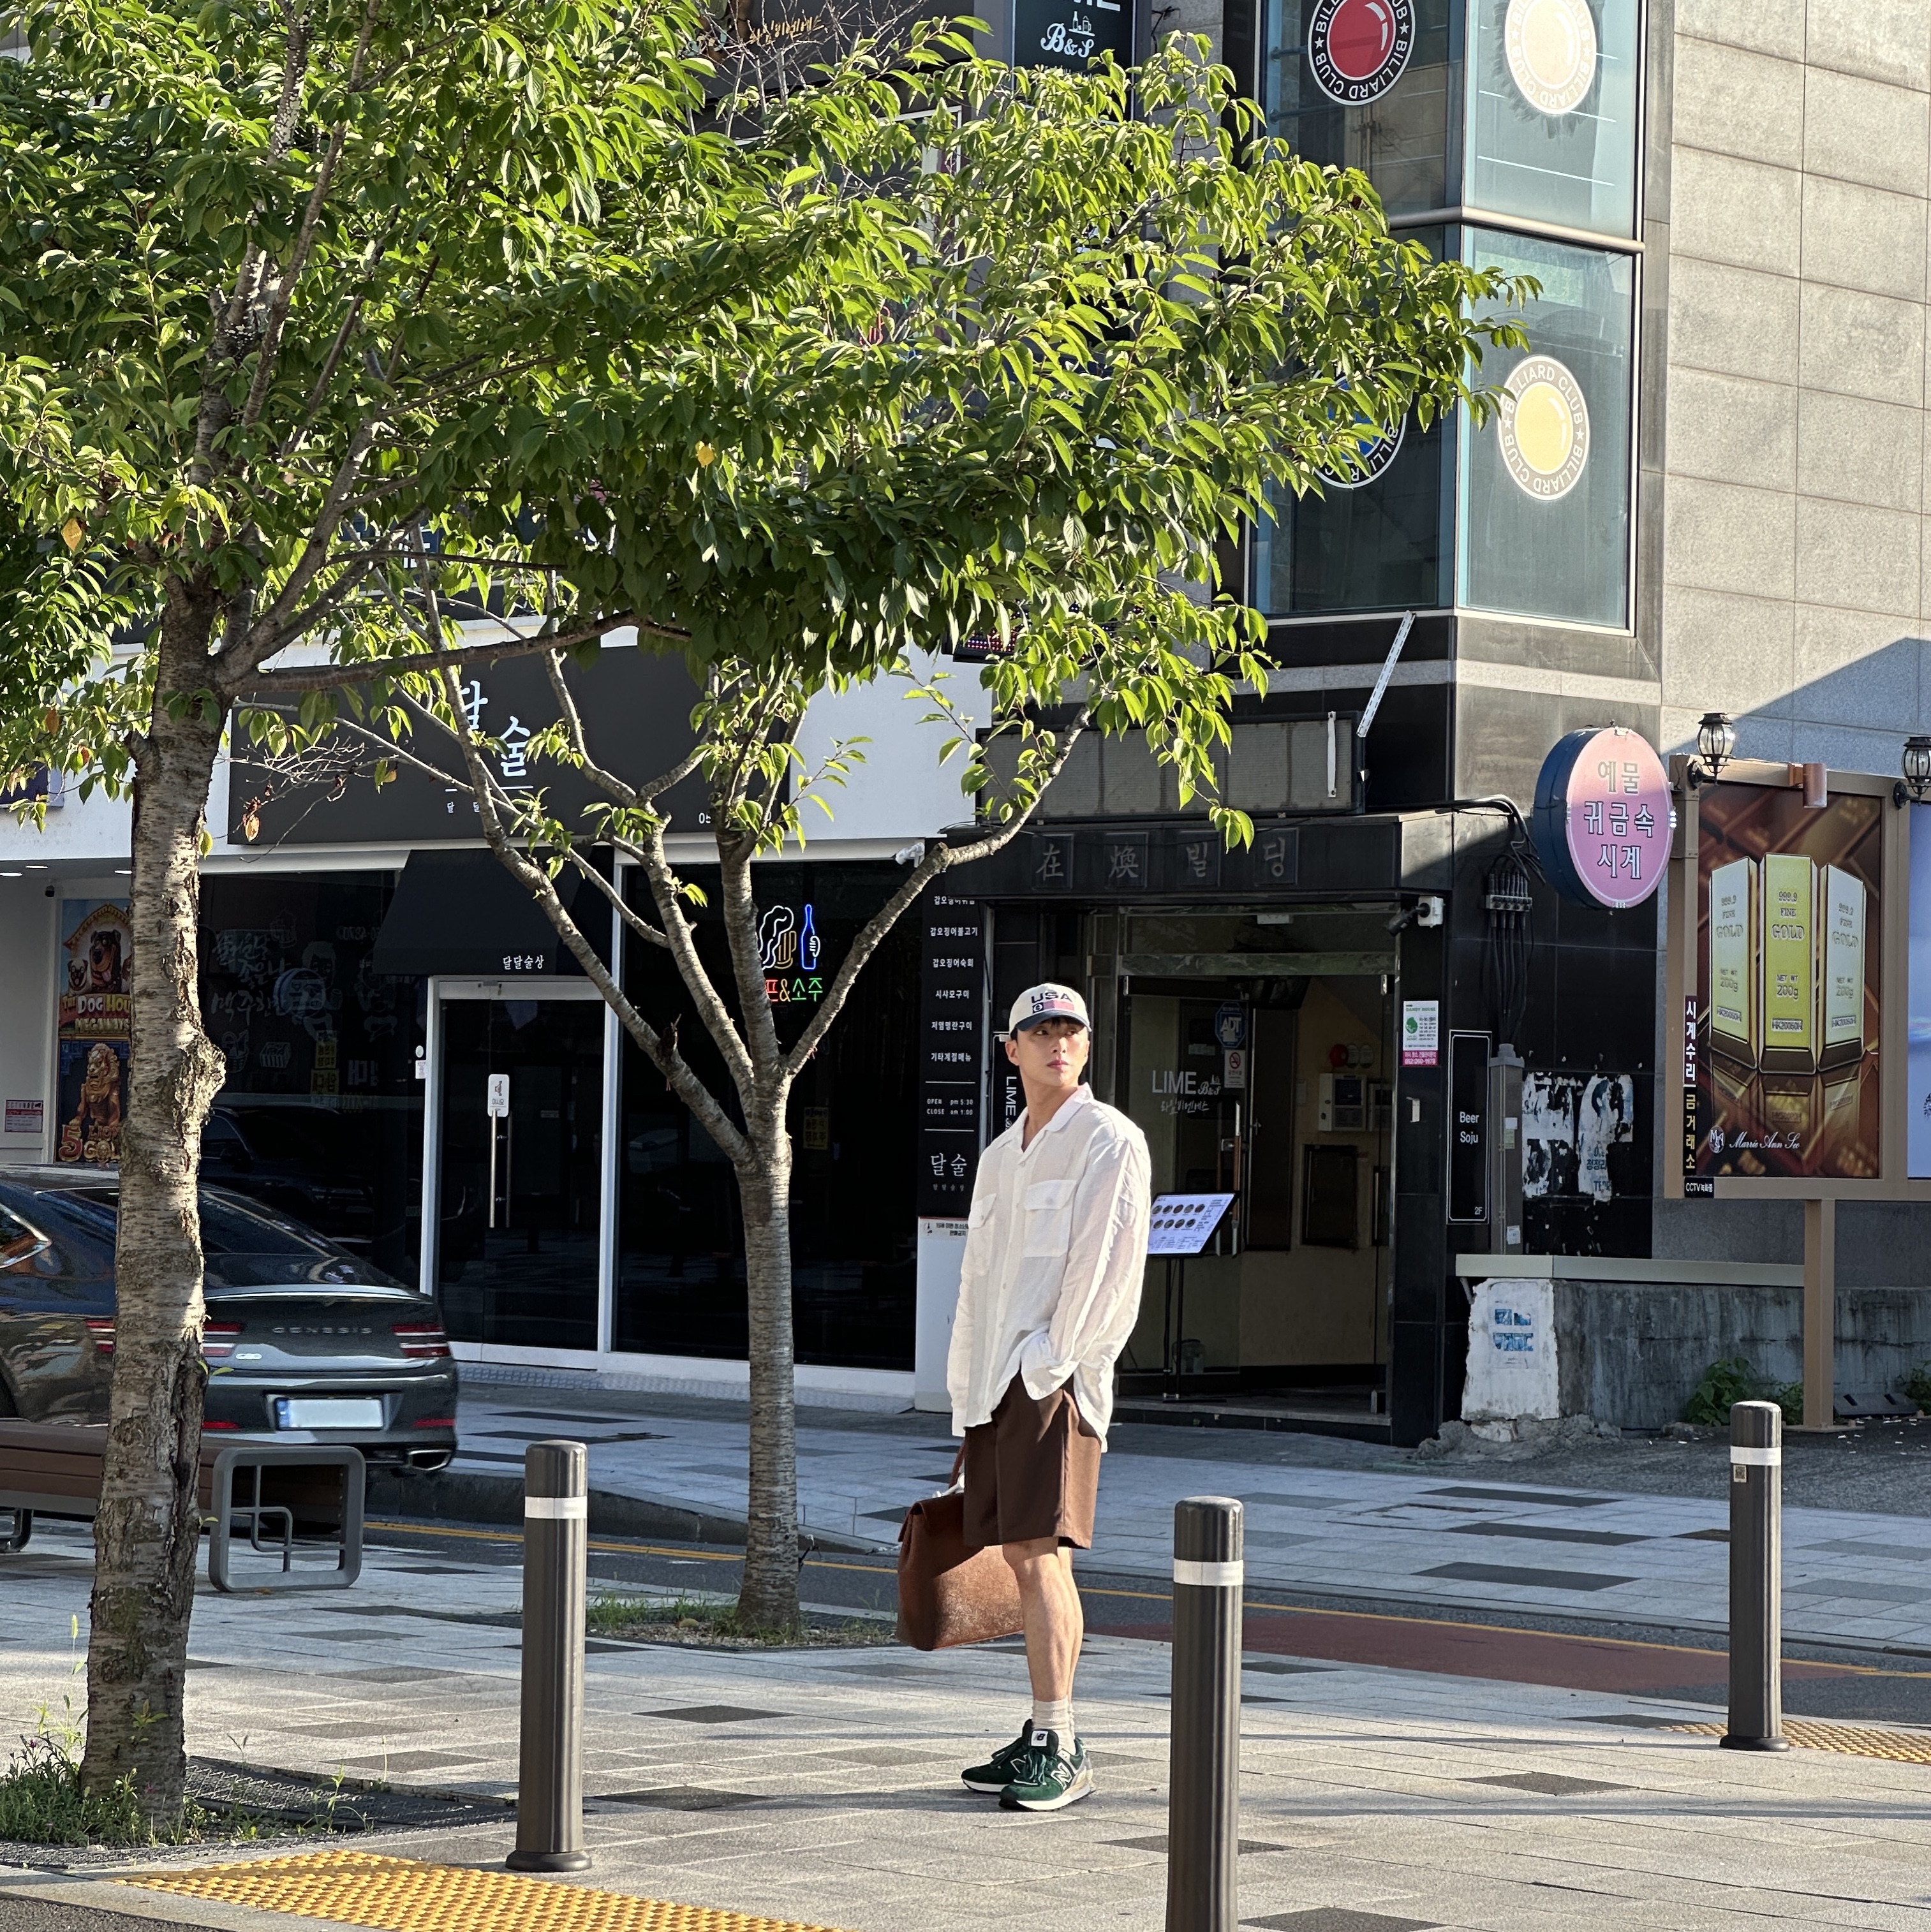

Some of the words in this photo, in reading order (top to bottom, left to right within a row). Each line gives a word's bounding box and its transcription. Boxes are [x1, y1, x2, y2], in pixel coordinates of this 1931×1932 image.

[1040, 23, 1095, 58] B&S
[1315, 52, 1345, 95] CLUB
[1349, 40, 1408, 99] BILLIARD
[1511, 46, 1537, 96] CLUB
[1539, 62, 1590, 108] BILLIARD
[1504, 364, 1555, 414] BLLIARD
[1558, 376, 1583, 425] CLUB
[1504, 434, 1530, 483] CLUB
[1533, 446, 1583, 494] BILLIARD
[1597, 760, 1640, 794] 예물
[1583, 801, 1655, 838] 귀금속
[1597, 844, 1641, 880] 시계
[1780, 907, 1796, 917] FINE
[1771, 924, 1805, 939] GOLD
[503, 954, 545, 970] 달달술상
[77, 995, 103, 1014] DOG
[766, 978, 824, 1002] 프&소주
[1031, 991, 1073, 1004] USA
[1777, 984, 1799, 1000] 200g
[1220, 1017, 1242, 1033] ADT
[1685, 1001, 1696, 1081] 시계수리
[1005, 1076, 1017, 1116] LIME
[1152, 1070, 1197, 1095] LIME
[1459, 1111, 1479, 1124] Beer
[1685, 1094, 1696, 1169] 금거래소
[1460, 1131, 1479, 1145] Soju
[930, 1153, 968, 1177] 달술
[1474, 1206, 1483, 1216] 2F
